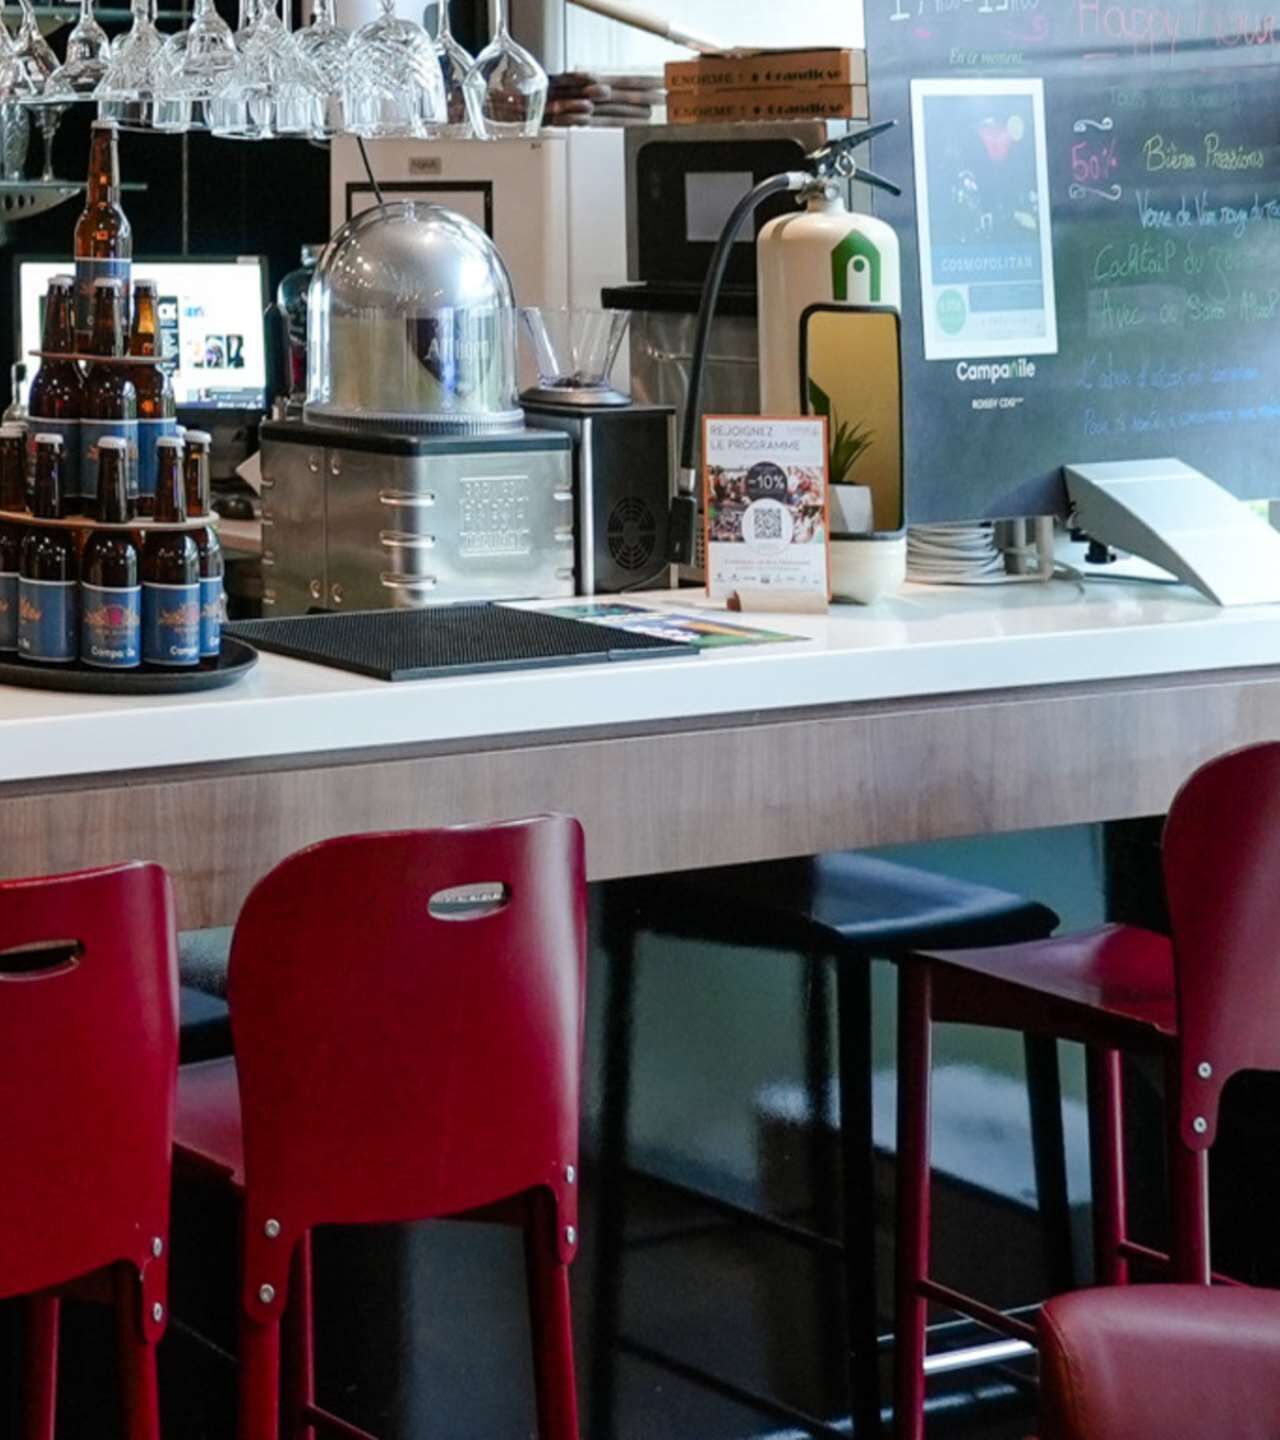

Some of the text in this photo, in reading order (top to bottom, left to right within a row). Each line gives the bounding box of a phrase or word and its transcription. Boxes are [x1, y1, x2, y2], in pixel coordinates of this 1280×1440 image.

[1072, 136, 1120, 182] 50%
[955, 357, 1036, 384] Campanile
[710, 424, 774, 438] REJOIGNEZ
[728, 439, 801, 452] PROGRAMME
